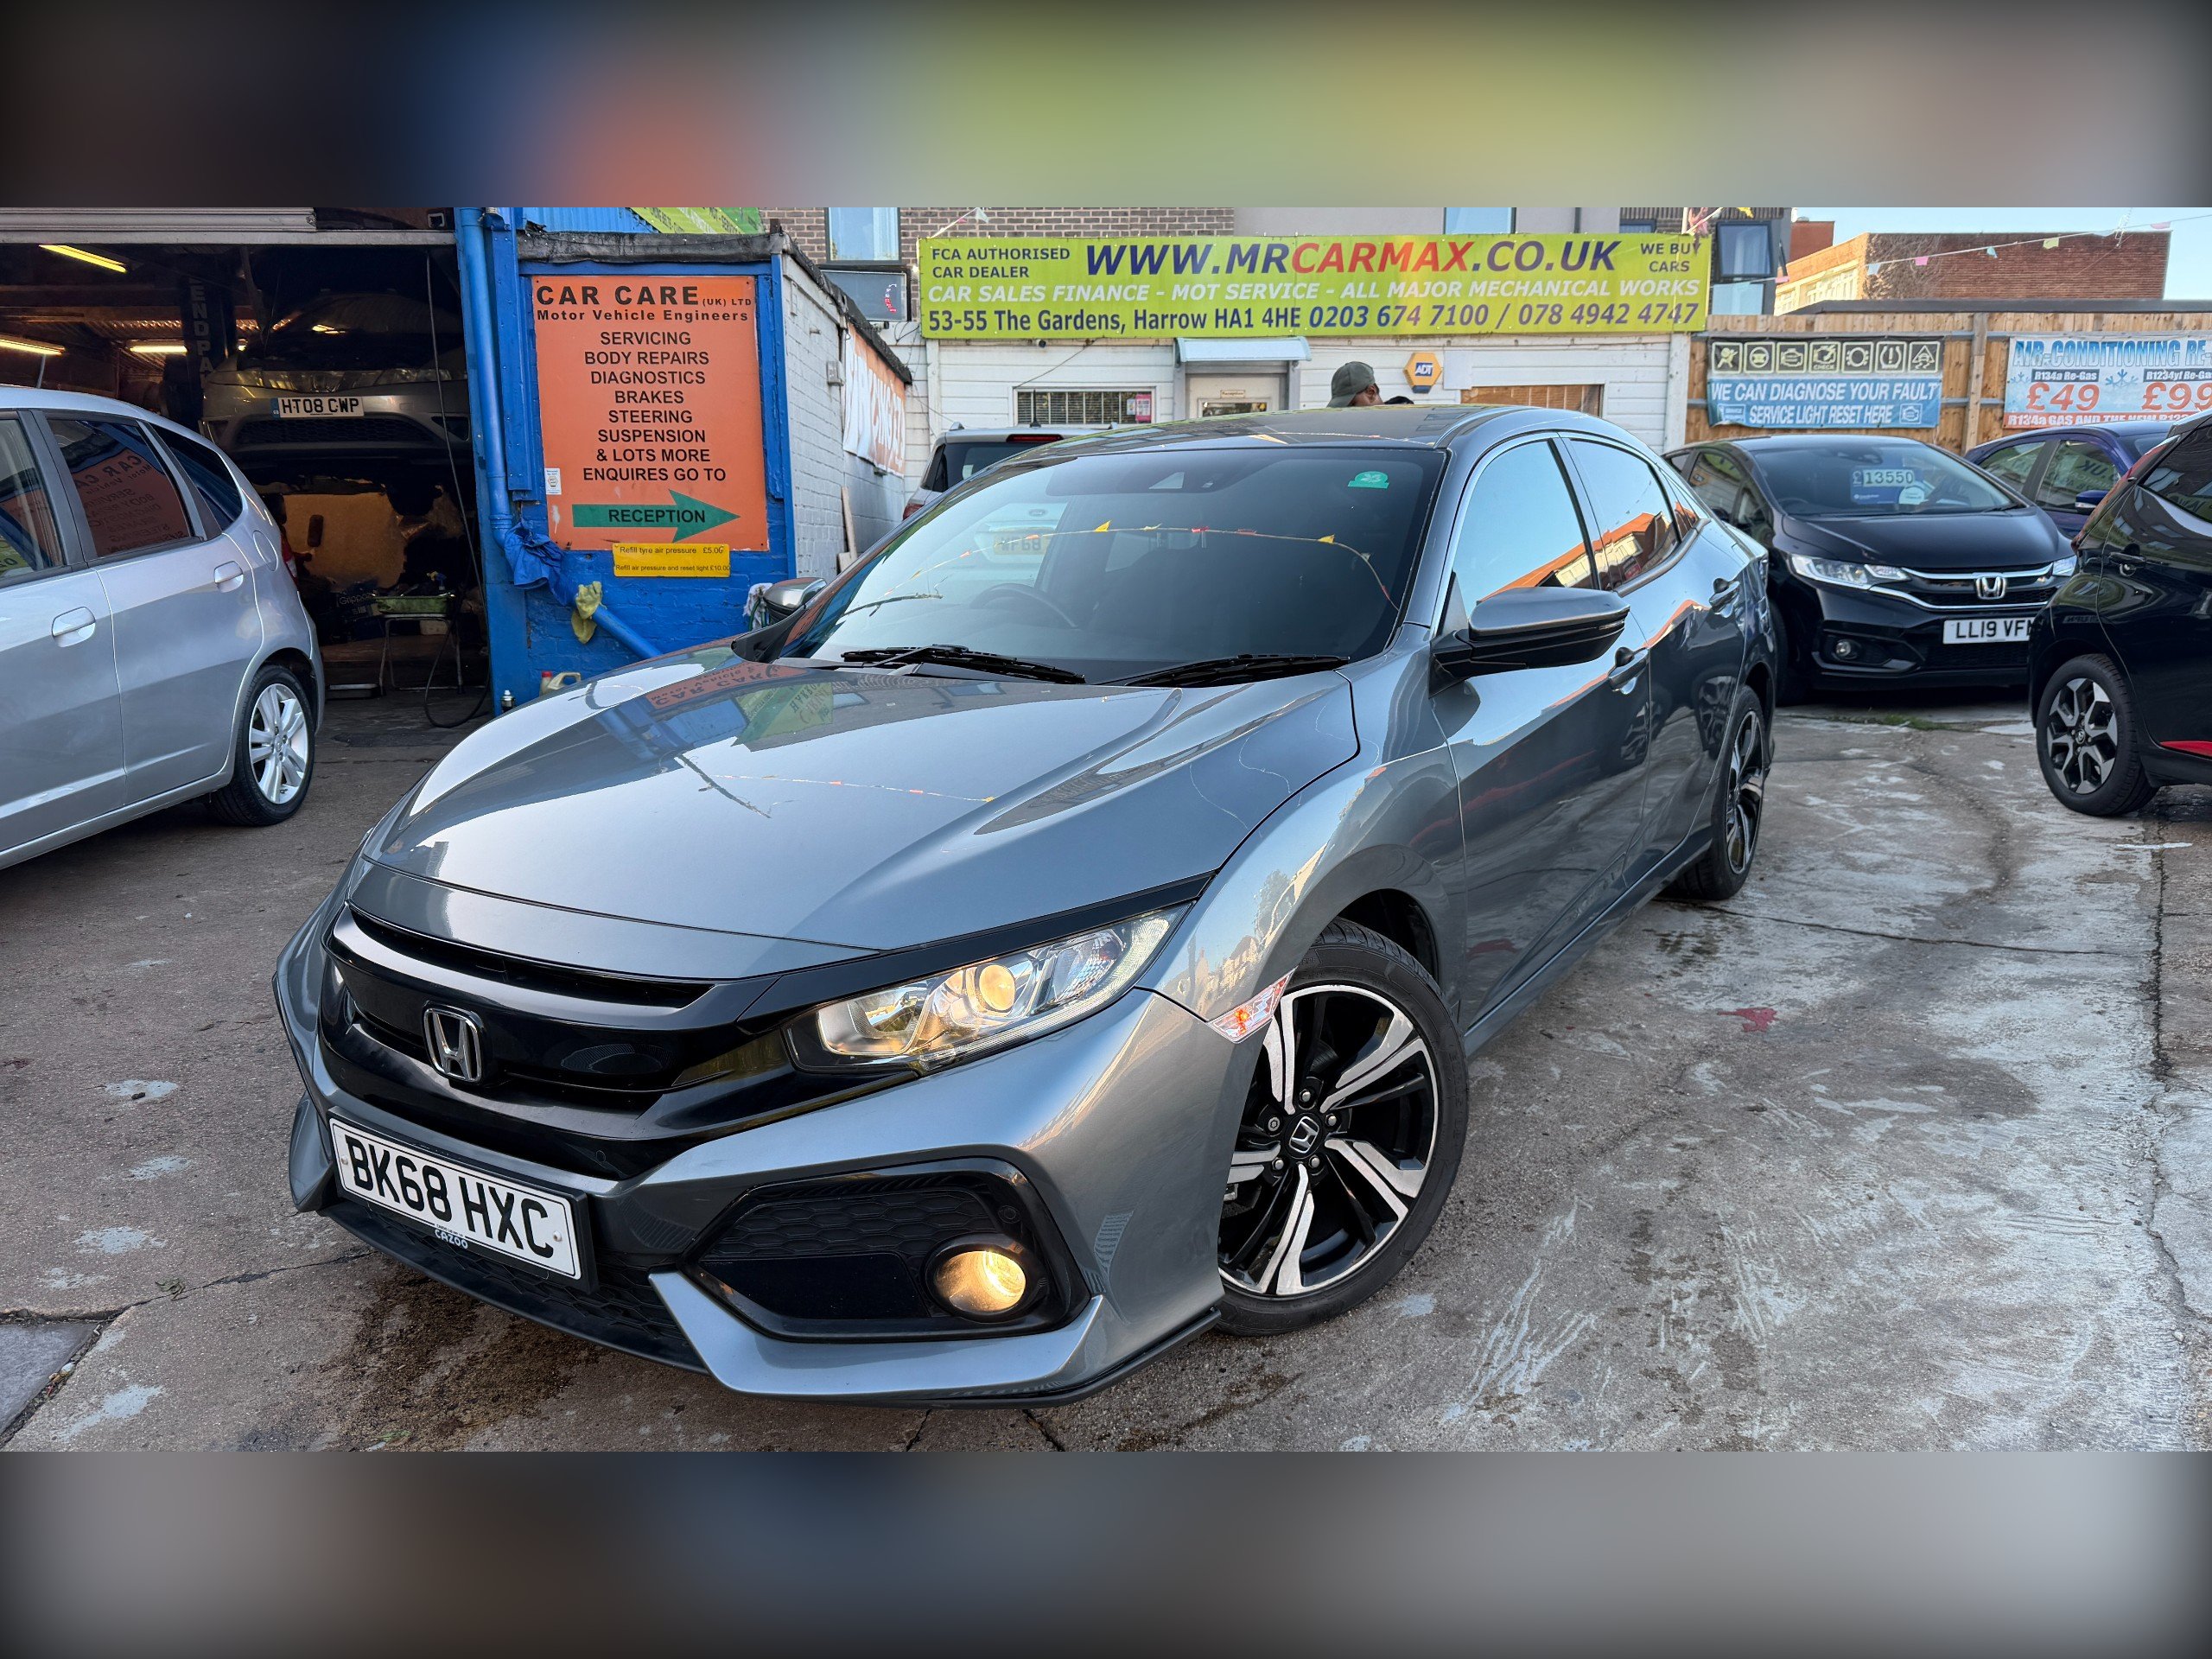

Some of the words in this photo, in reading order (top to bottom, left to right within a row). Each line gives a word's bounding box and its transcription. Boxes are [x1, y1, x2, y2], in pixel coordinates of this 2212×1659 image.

[932, 248, 961, 260] FCA
[967, 248, 1071, 260] AUTHORISED
[1640, 243, 1664, 255] WE
[1669, 243, 1701, 255] BUY
[1087, 240, 1622, 276] WWW.MRCARMAX.CO.UK
[932, 266, 963, 278] CAR
[969, 266, 1030, 278] DEALER
[1649, 260, 1690, 272] CARS
[536, 285, 599, 306] CAR
[614, 285, 699, 306] CARE
[702, 298, 727, 308] (UK)
[731, 298, 752, 307] LTD
[928, 285, 972, 302] CAR
[977, 284, 1046, 302] SALES
[1052, 284, 1150, 302] FINANCE
[1171, 283, 1220, 301] MOT
[1224, 283, 1320, 300] SERVICE
[1340, 282, 1380, 299] ALL
[1387, 281, 1462, 298] MAJOR
[1469, 280, 1611, 297] MECHANICAL
[1619, 279, 1700, 296] WORKS
[537, 309, 585, 321] Motor
[593, 309, 656, 321] Vehicle
[663, 309, 749, 324] Engineers
[929, 309, 988, 331] 53-55
[994, 309, 1031, 331] The
[1038, 308, 1127, 334] Gardens,
[1134, 308, 1207, 330] Harrow
[1215, 308, 1254, 328] HA1
[1262, 307, 1301, 328] 4HE
[1308, 305, 1369, 327] 0203
[1376, 305, 1421, 327] 674
[1429, 303, 1489, 327] 7100
[1494, 302, 1511, 330] /
[1518, 302, 1564, 326] 078
[1570, 302, 1630, 326] 4942
[1637, 302, 1699, 324] 4747
[600, 331, 691, 346] SERVICING
[584, 351, 632, 365] BODY
[637, 351, 709, 365] REPAIRS
[2012, 340, 2181, 367] AIR-CONDITIONING
[1415, 364, 1433, 375] ADT
[2034, 371, 2063, 380] R134a
[2064, 371, 2097, 380] Re-Gas
[590, 371, 706, 385] DIAGNOSTICS
[614, 391, 684, 404] BRAKES
[1711, 383, 1732, 401] WE
[1734, 383, 1767, 401] CAN
[1769, 382, 1845, 401] DIAGNOSE
[1849, 382, 1890, 401] YOUR
[1892, 382, 1938, 400] FAULT
[2025, 382, 2100, 411] £49
[281, 398, 324, 414] HT08
[327, 397, 359, 413] CWP
[608, 410, 693, 423] STEERING
[1749, 405, 1795, 424] SERVICE
[1796, 405, 1828, 424] LIGHT
[1828, 405, 1865, 424] RESET
[1865, 404, 1894, 424] HERE
[2007, 415, 2046, 426] R134a
[2048, 415, 2074, 426] GAS
[2075, 415, 2101, 425] AND
[598, 429, 706, 443] SUSPENSION
[596, 448, 607, 461] &
[613, 448, 657, 462] LOTS
[661, 448, 711, 462] MORE
[583, 467, 669, 482] ENQUIRES
[673, 467, 699, 481] GO
[704, 467, 727, 481] TO
[608, 509, 706, 524] RECEPTION
[1955, 620, 1998, 639] LL19
[345, 1134, 453, 1223] BK68
[458, 1176, 555, 1259] HXC
[435, 1229, 468, 1249] CAZOO
